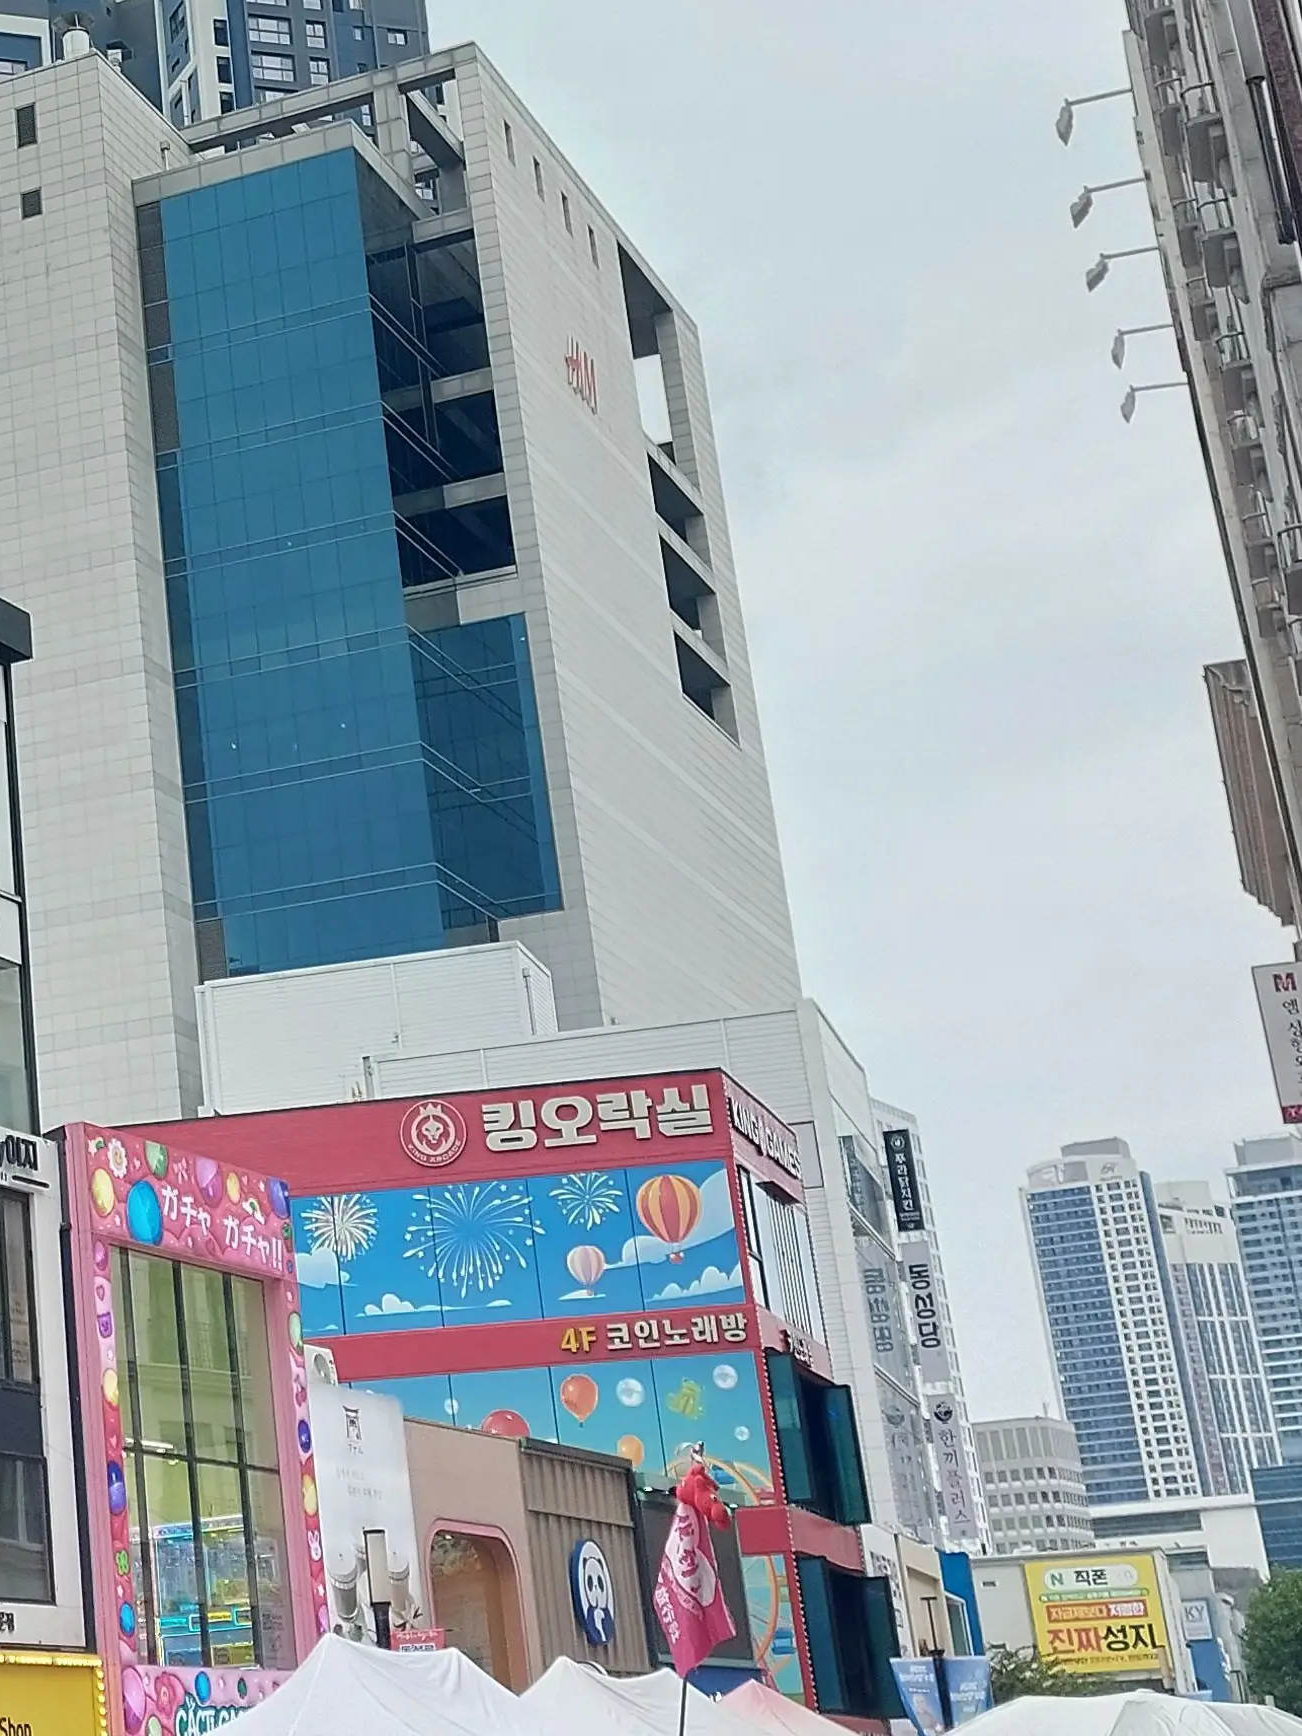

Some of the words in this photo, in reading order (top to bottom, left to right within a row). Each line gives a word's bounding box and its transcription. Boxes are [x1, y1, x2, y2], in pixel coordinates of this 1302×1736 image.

[482, 1084, 713, 1152] 킹오락실
[728, 1097, 759, 1144] KING
[162, 1185, 211, 1236] ガチャ
[561, 1327, 597, 1353] 4F
[606, 1312, 748, 1350] 코인노래방
[1074, 1569, 1109, 1587] 직폰
